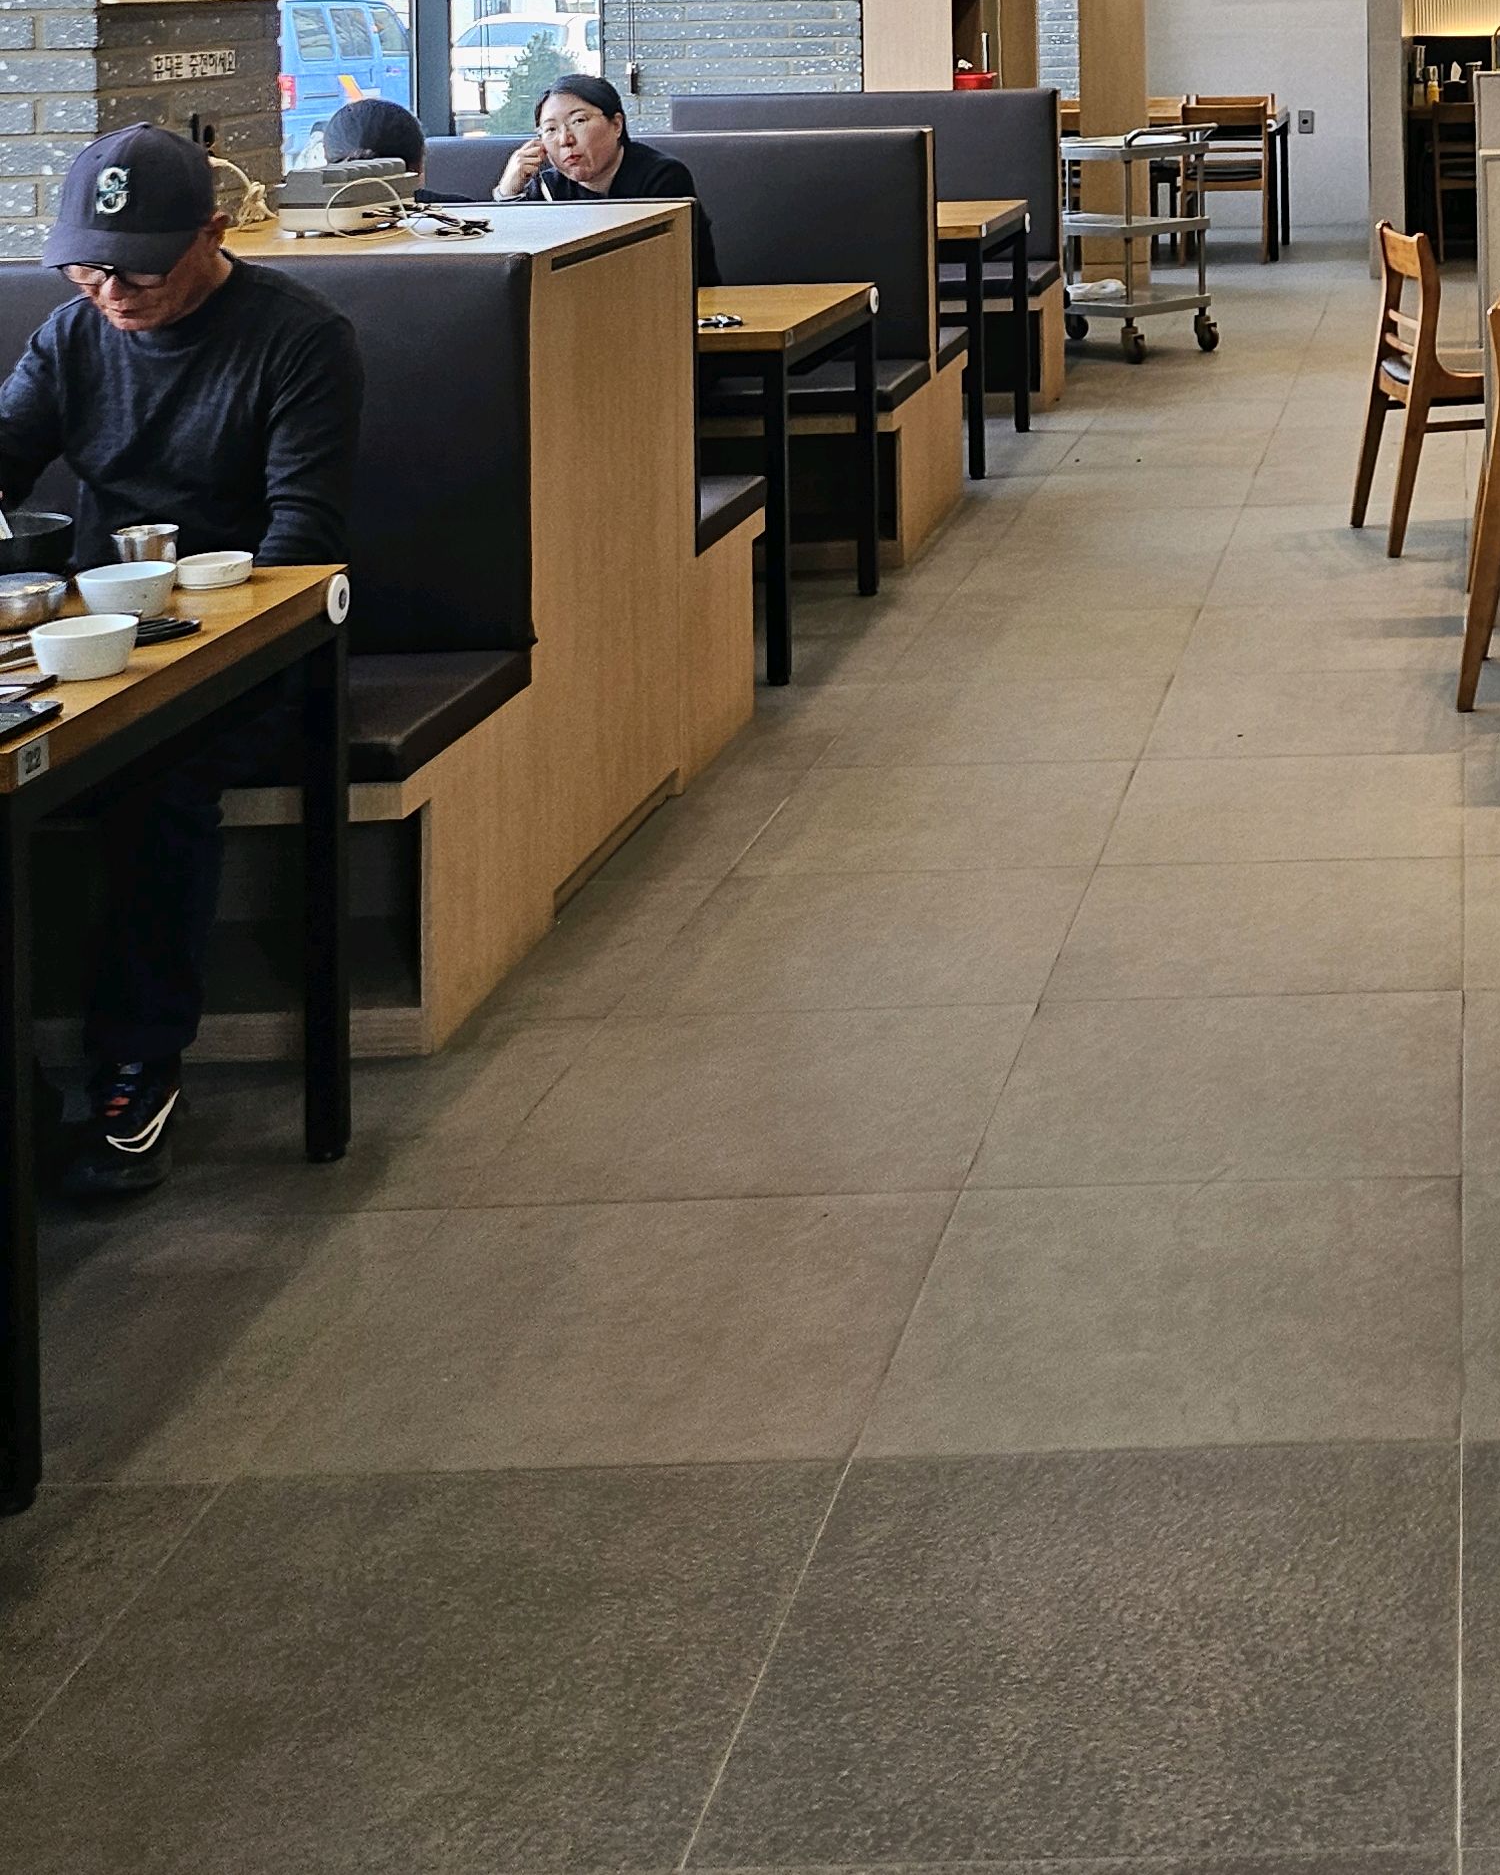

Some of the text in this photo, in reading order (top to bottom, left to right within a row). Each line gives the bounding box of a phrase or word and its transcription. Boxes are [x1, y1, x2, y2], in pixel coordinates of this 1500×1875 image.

[153, 51, 235, 79] 휴대폰 충전하세요
[96, 167, 131, 214] S
[25, 746, 41, 774] 22
